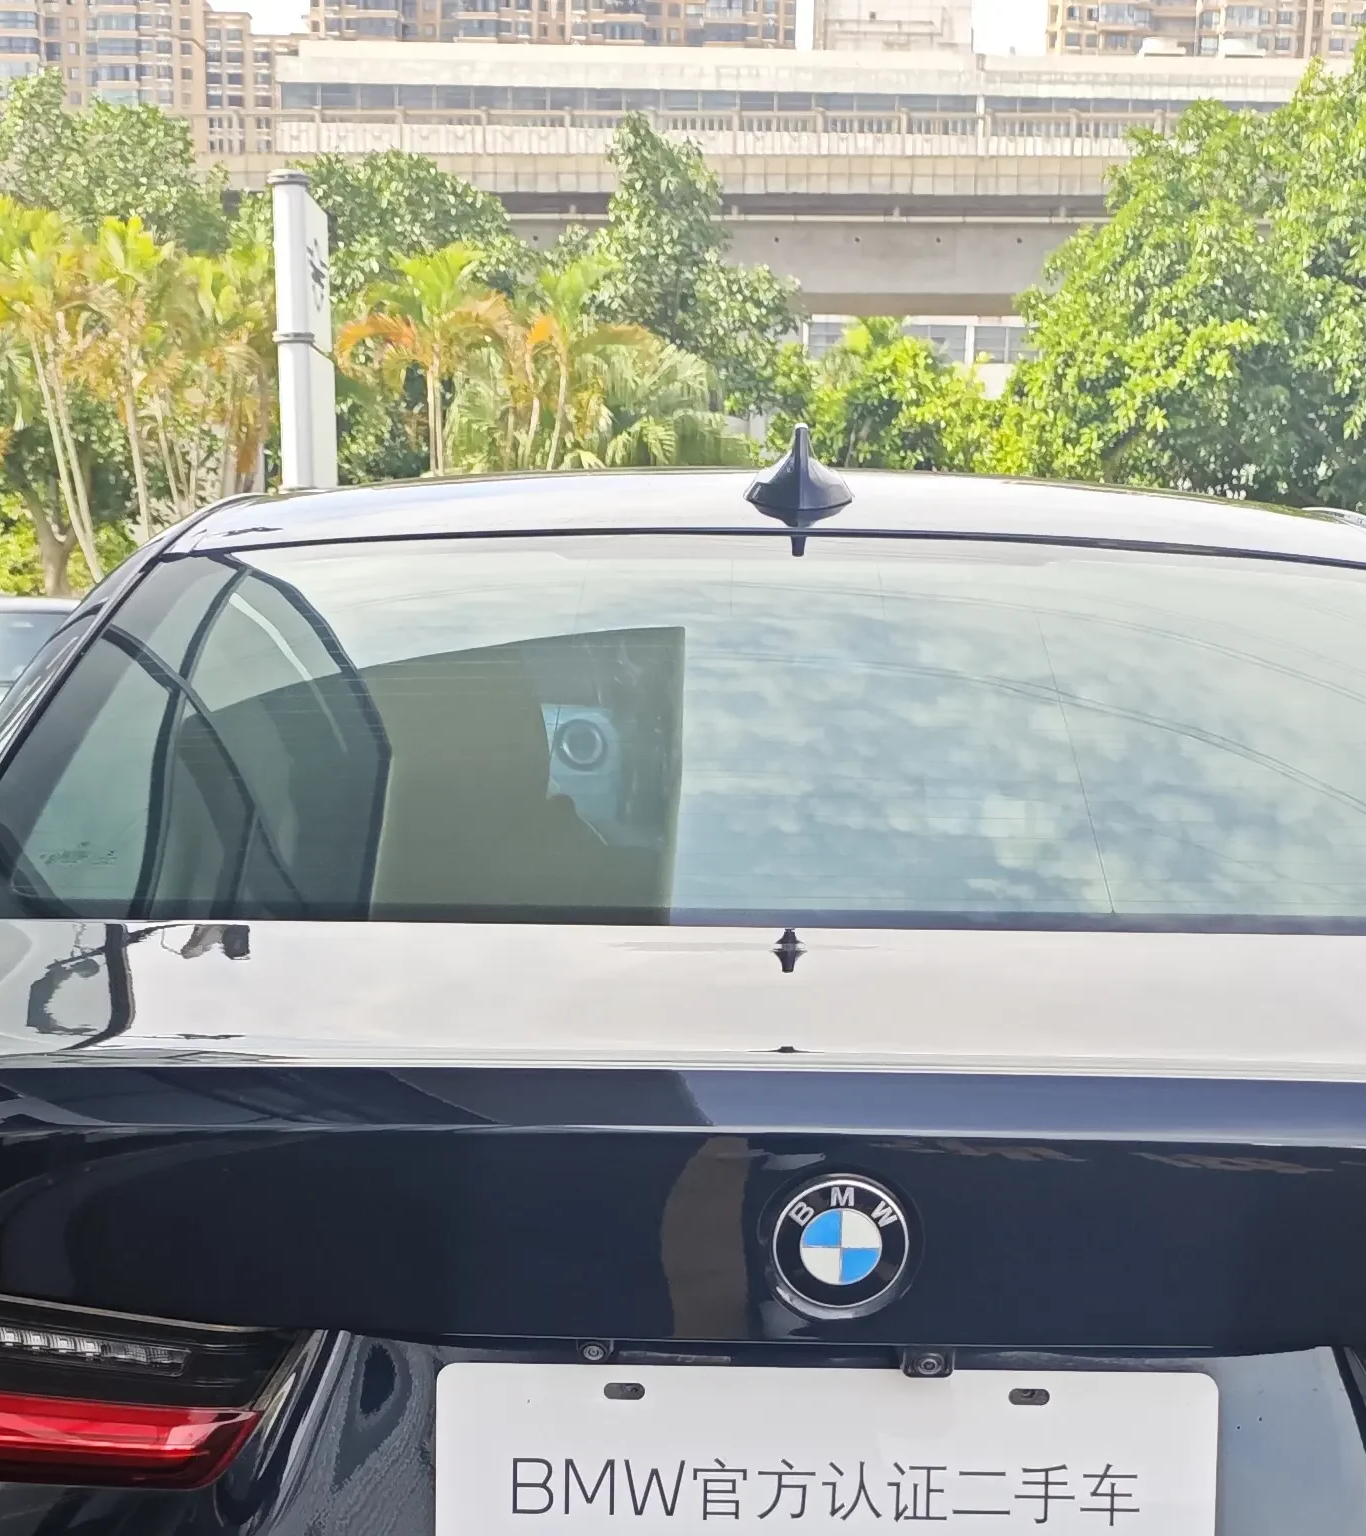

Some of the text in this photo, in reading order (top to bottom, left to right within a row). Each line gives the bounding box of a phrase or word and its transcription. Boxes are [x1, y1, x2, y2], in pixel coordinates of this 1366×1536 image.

[788, 1186, 898, 1228] BMW
[511, 1457, 1141, 1527] BMW官方认证二手车
